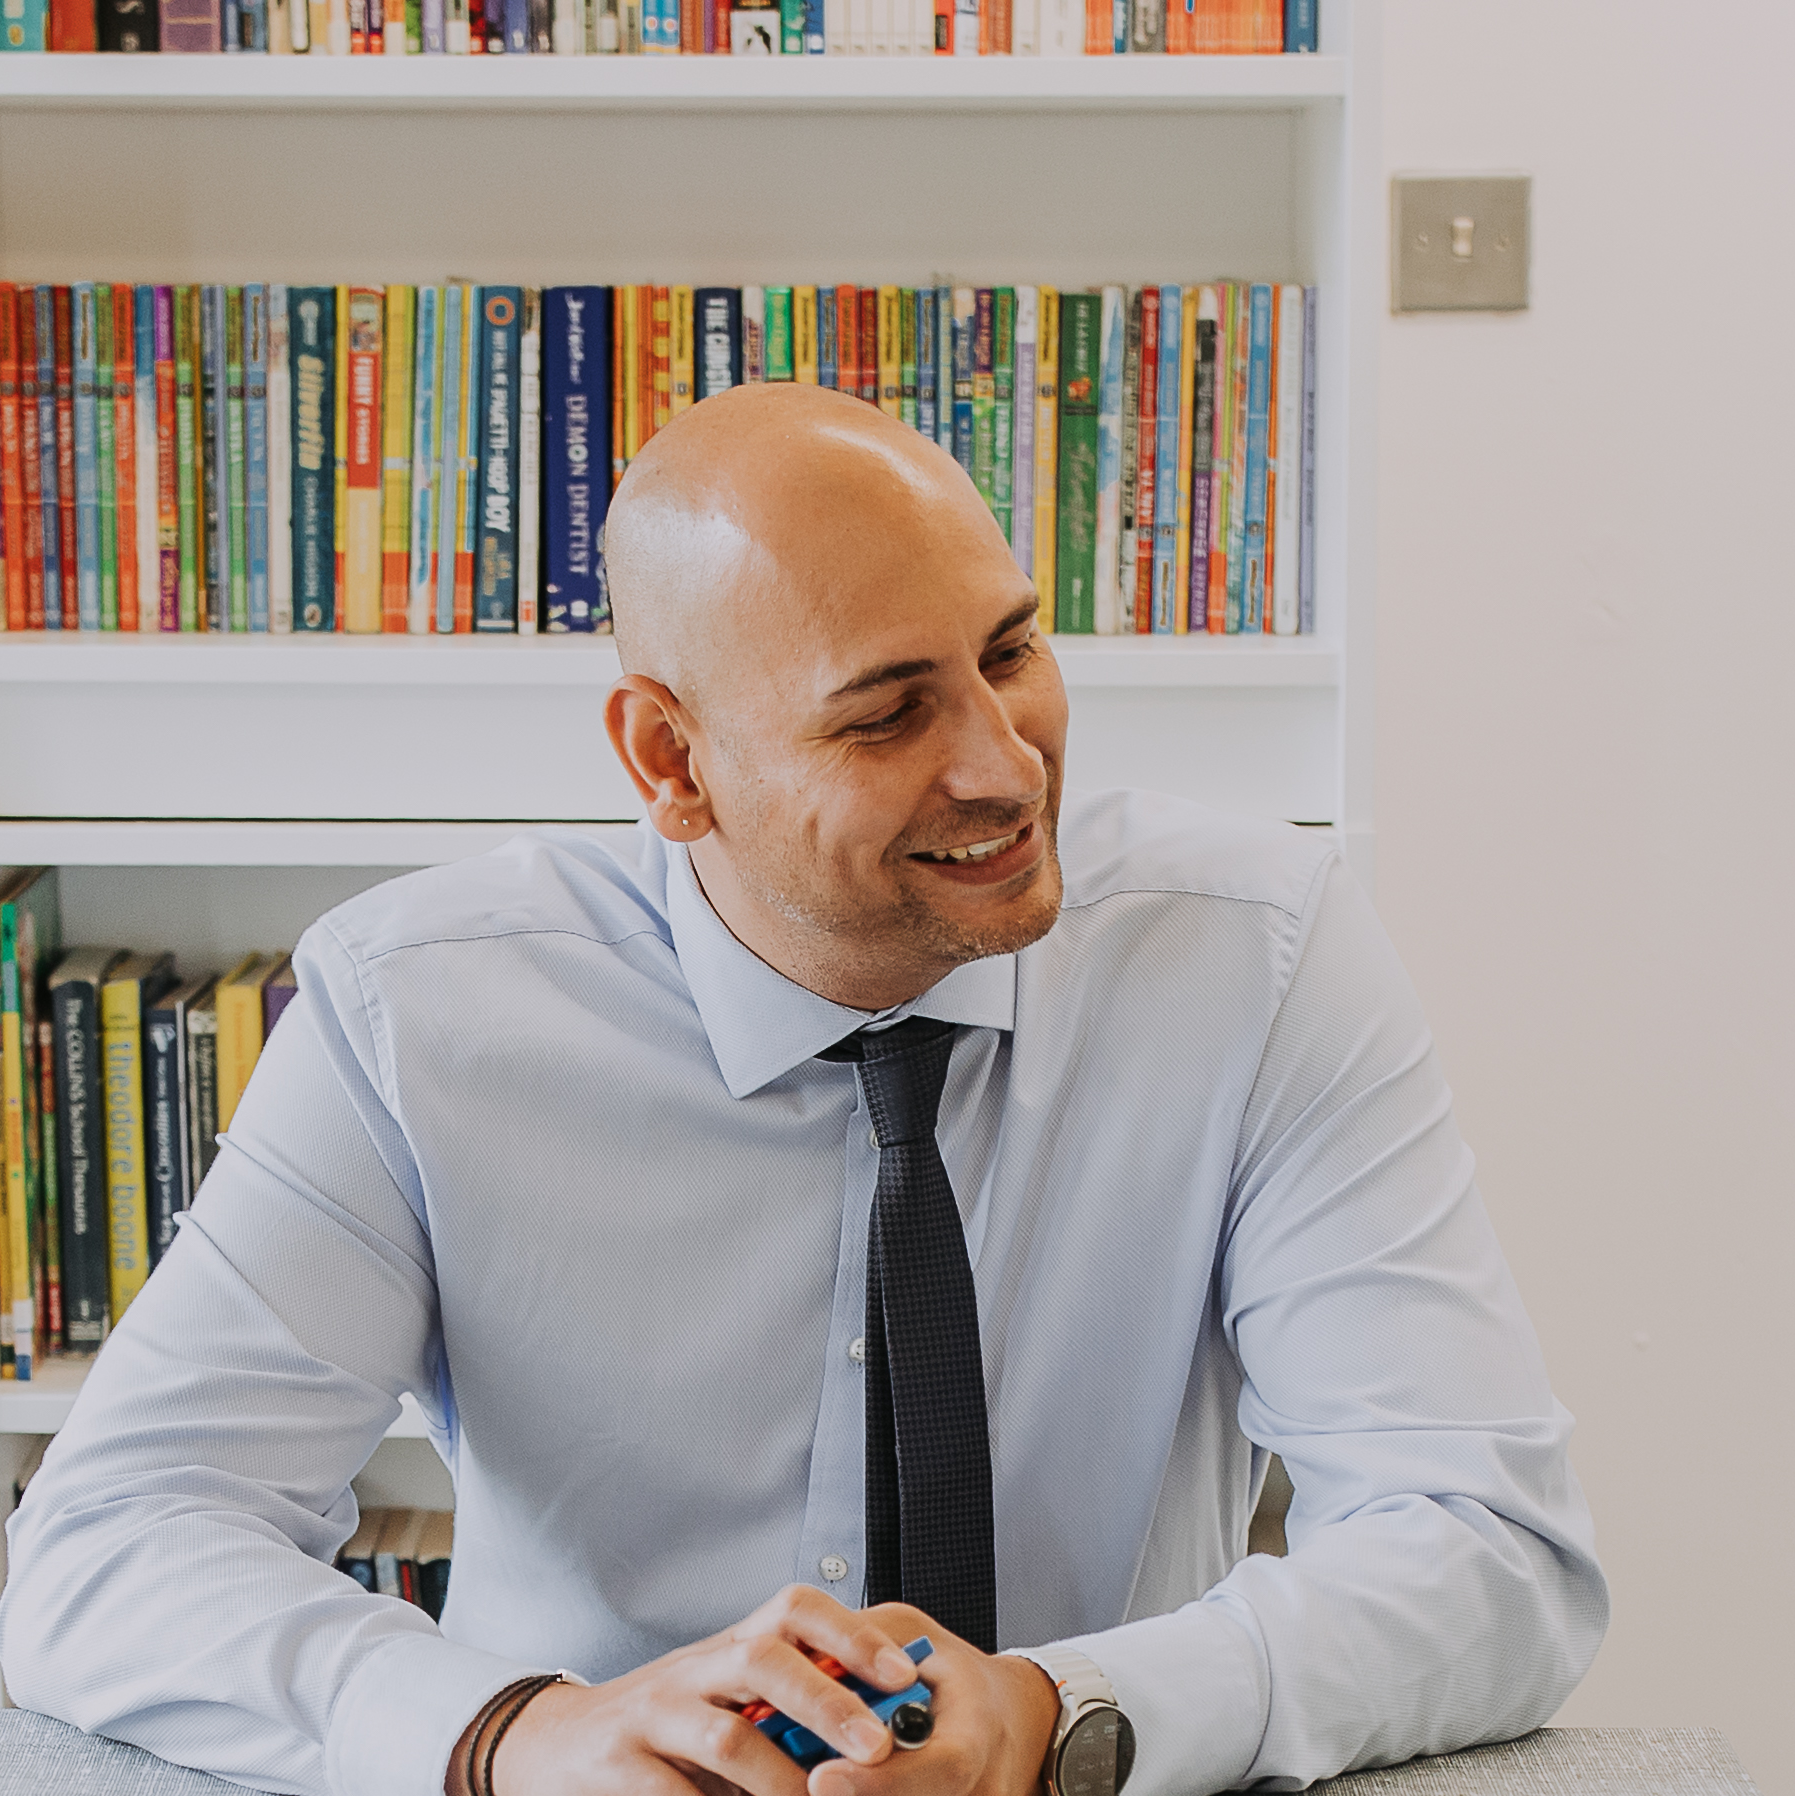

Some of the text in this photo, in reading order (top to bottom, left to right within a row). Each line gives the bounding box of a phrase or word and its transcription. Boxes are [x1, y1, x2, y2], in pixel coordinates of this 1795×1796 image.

[705, 298, 729, 330] THE
[354, 357, 373, 405] FUNNY
[486, 495, 511, 532] BOY
[566, 394, 590, 576] DEMON DENTIST
[65, 998, 90, 1235] The COLLINS School Thesaurus
[106, 1041, 140, 1271] theodore boone
